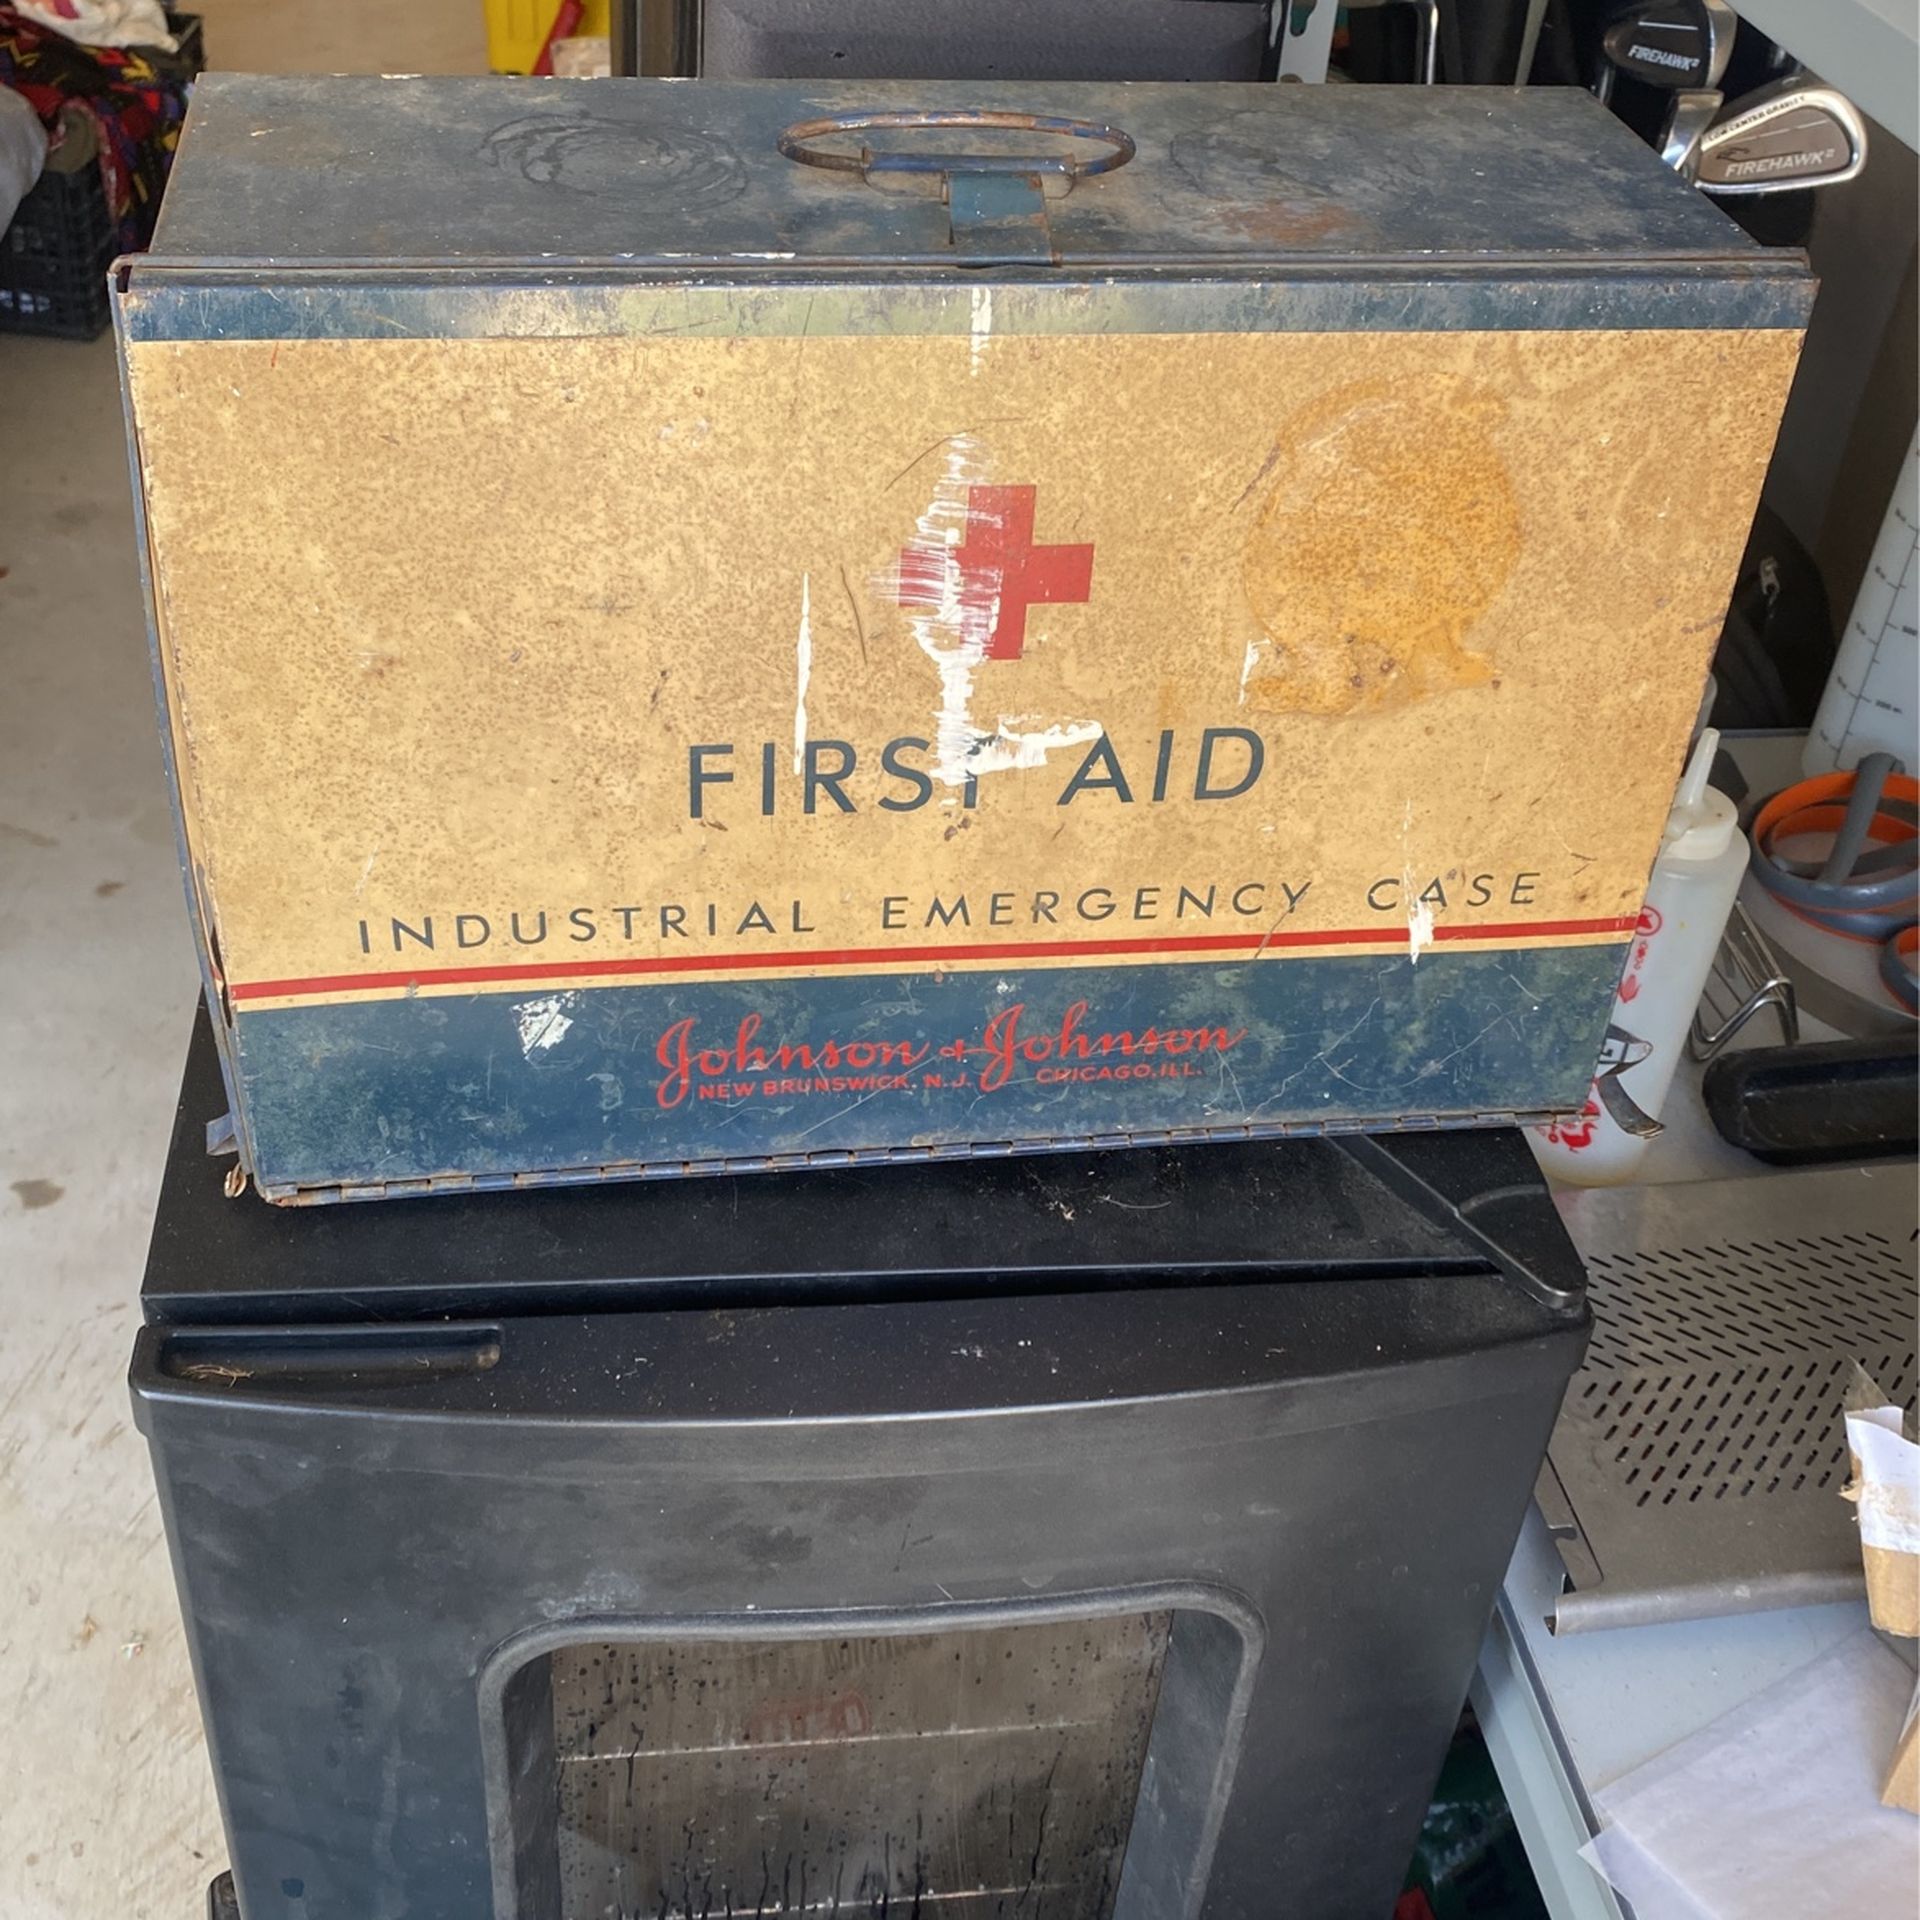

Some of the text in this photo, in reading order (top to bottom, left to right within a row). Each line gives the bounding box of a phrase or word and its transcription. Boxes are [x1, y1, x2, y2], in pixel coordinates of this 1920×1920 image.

[1056, 727, 1265, 806] AID
[359, 872, 1541, 954] INDUSTRIAL EMERGENCY CASE
[656, 1012, 931, 1110] Johnson
[979, 999, 1249, 1093] Johnson
[700, 1081, 757, 1100] NEW
[924, 1072, 972, 1089] N.J.
